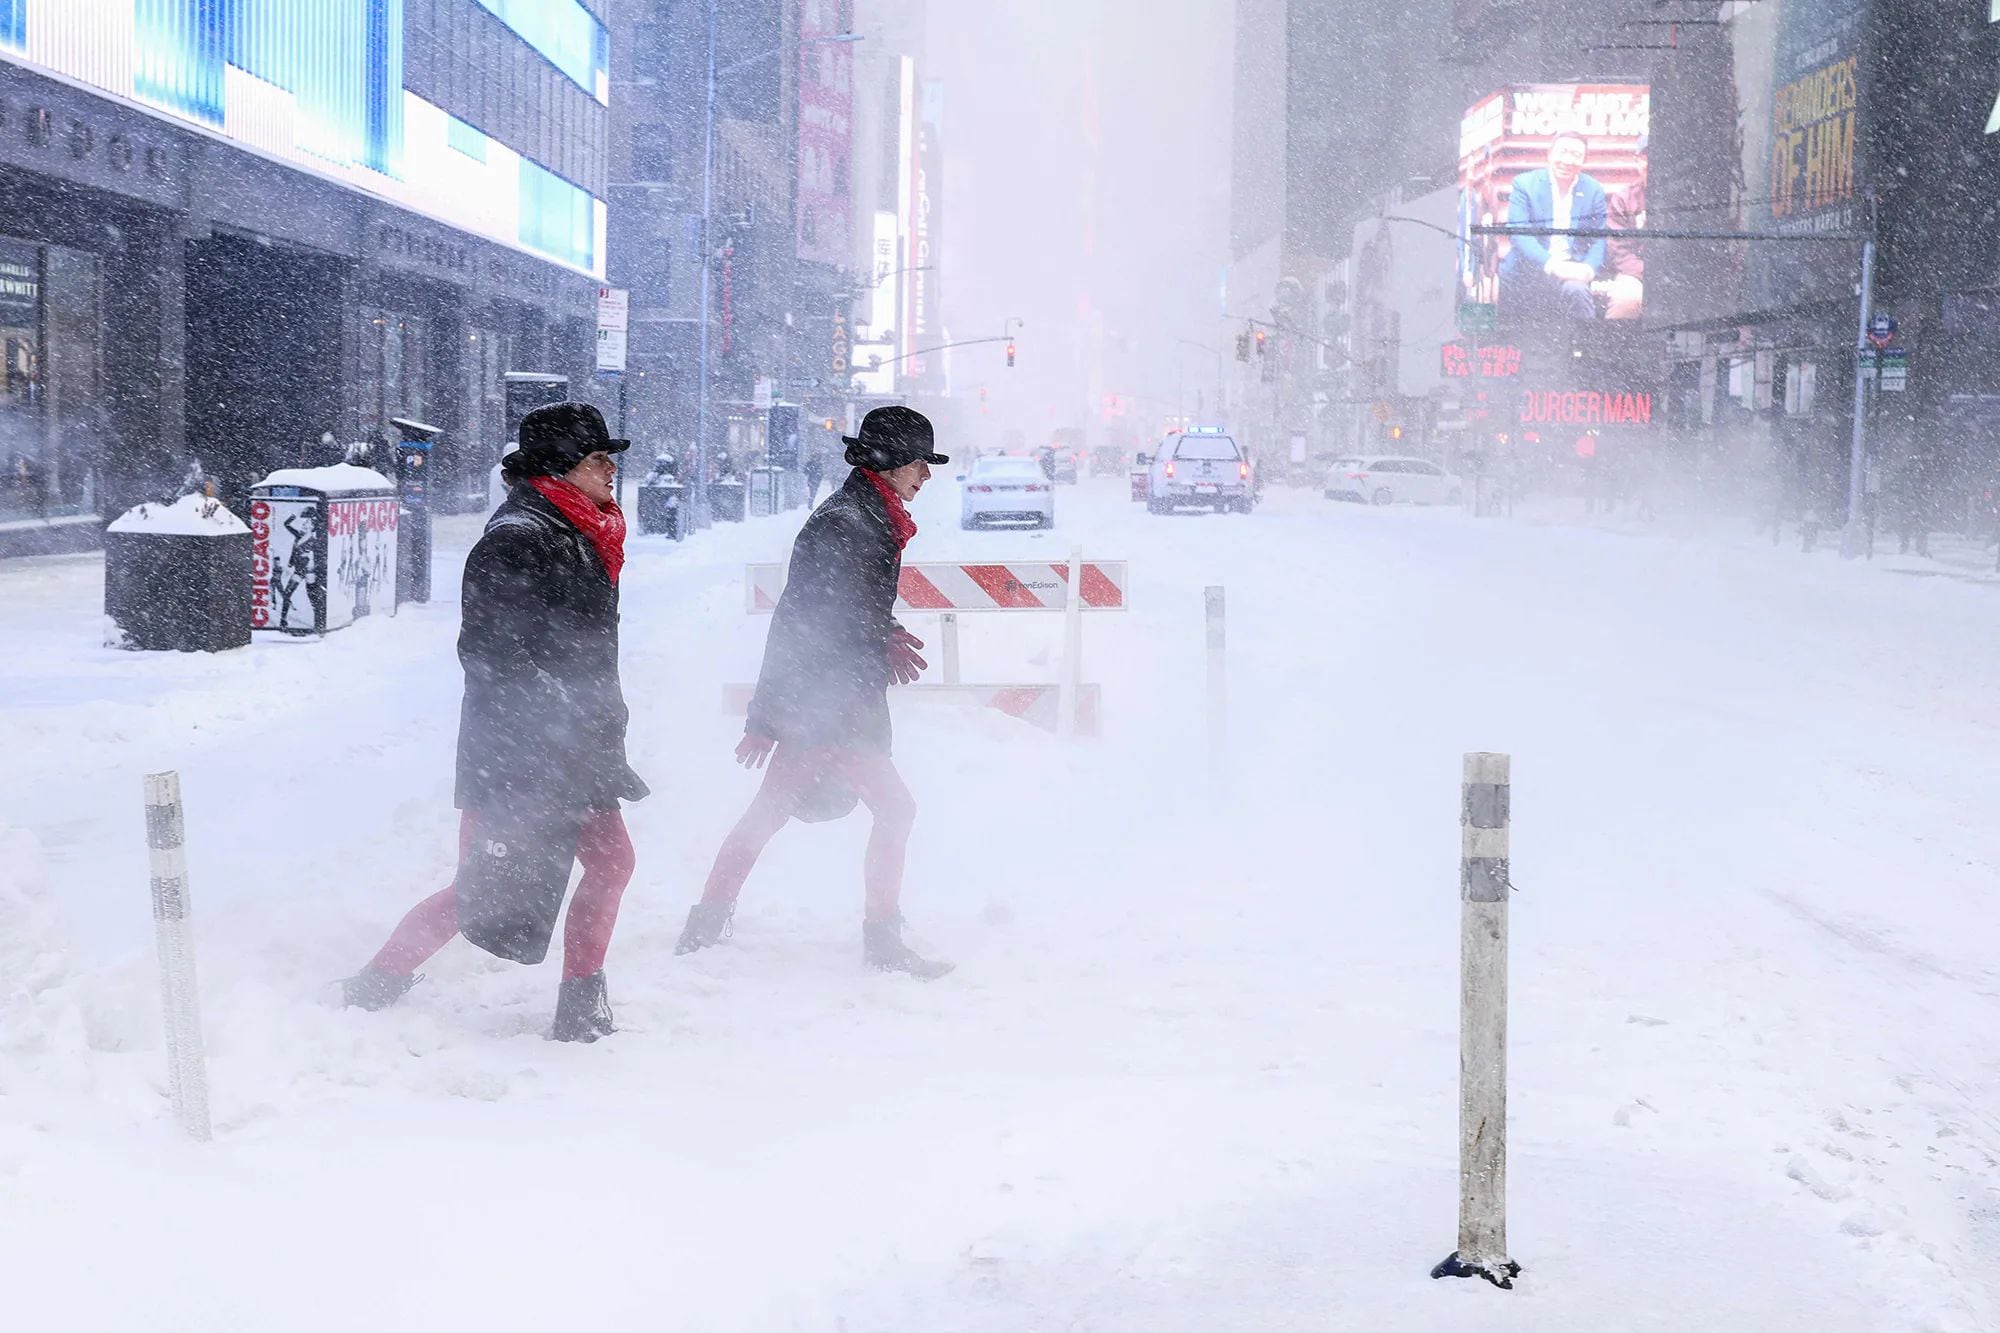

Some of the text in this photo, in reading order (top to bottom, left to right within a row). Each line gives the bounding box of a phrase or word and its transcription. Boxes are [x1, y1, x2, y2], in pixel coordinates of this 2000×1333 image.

[1776, 55, 1857, 134] REMINDERS
[1772, 112, 1856, 219] OF HIM
[832, 309, 847, 376] LAGO
[328, 501, 398, 537] CHICAGO
[251, 501, 271, 627] CHICAGO
